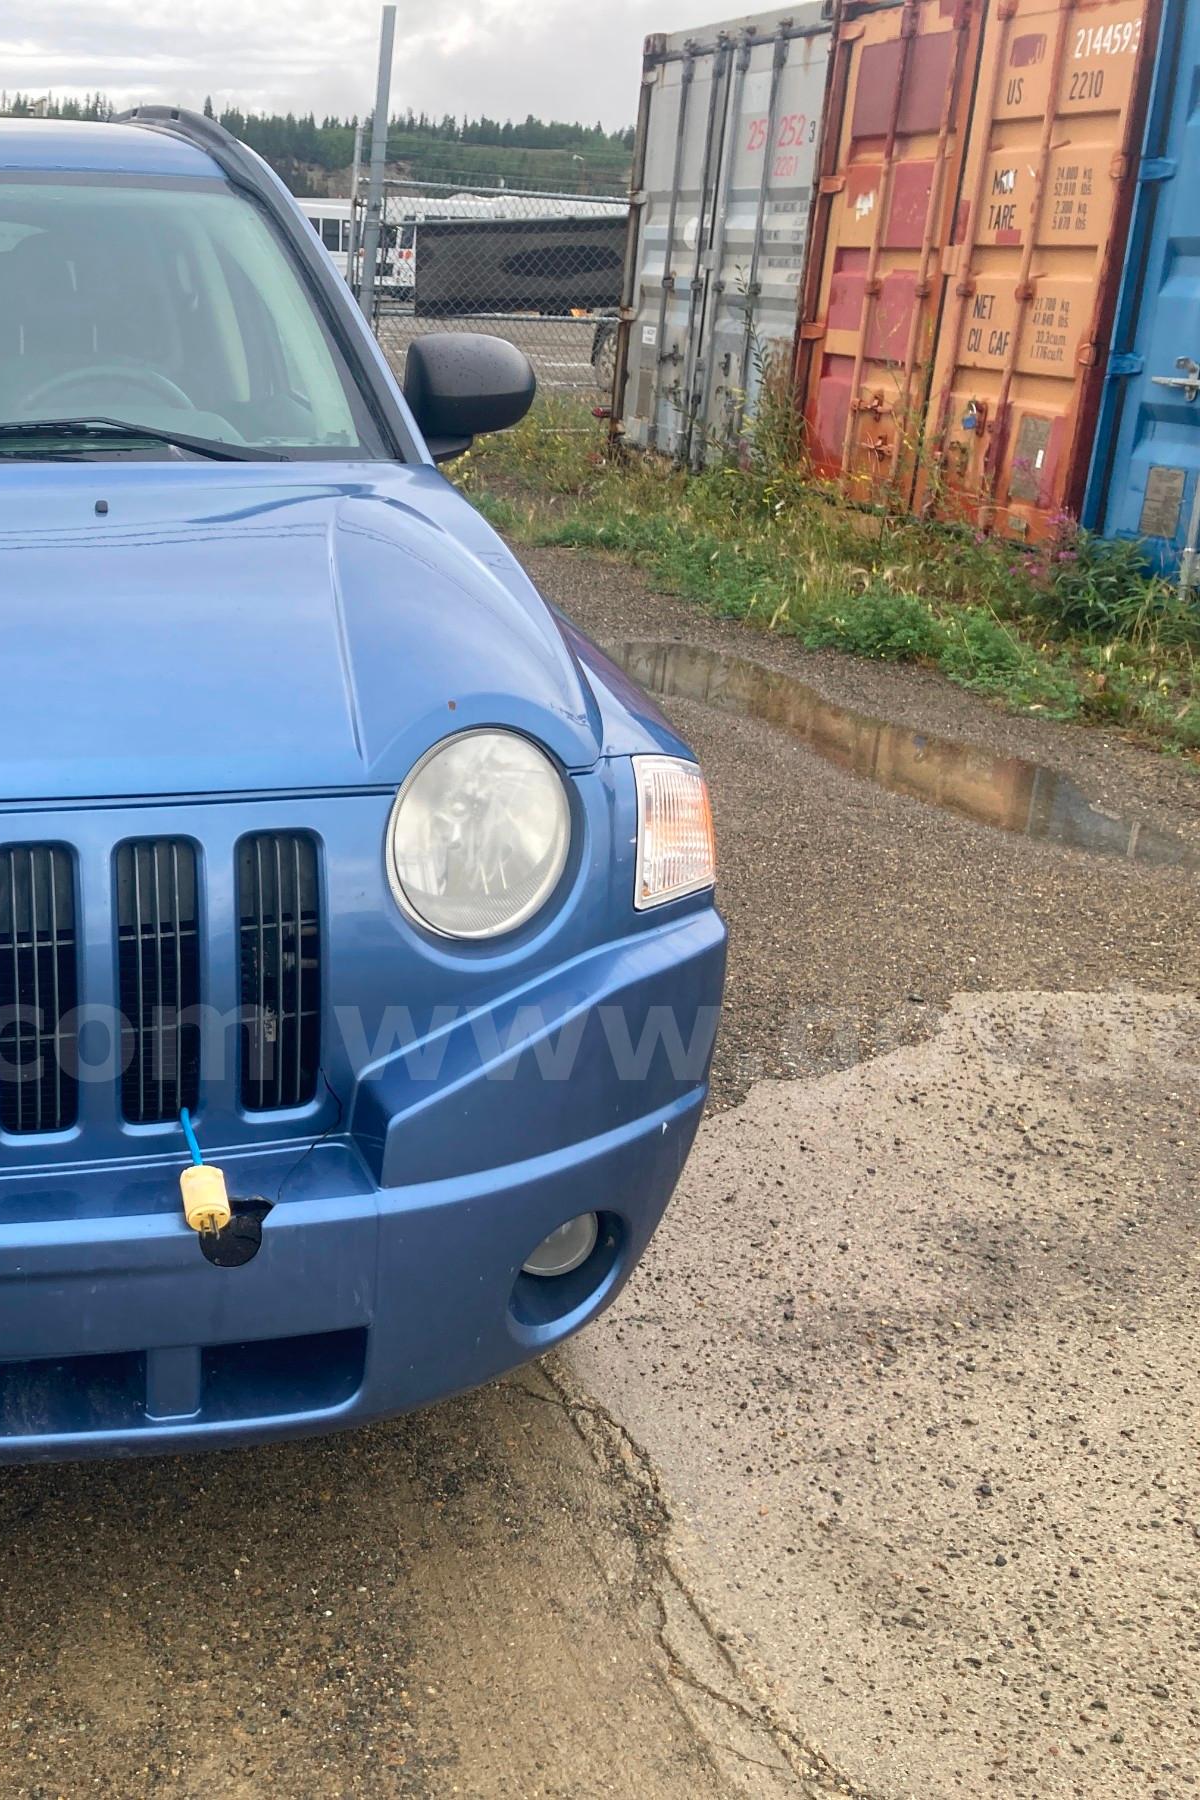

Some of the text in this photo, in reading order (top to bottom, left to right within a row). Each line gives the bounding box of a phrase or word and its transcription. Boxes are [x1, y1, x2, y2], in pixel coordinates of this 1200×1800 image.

[1006, 70, 1104, 105] US 2210
[988, 204, 1016, 230] TARE
[973, 294, 996, 320] NET
